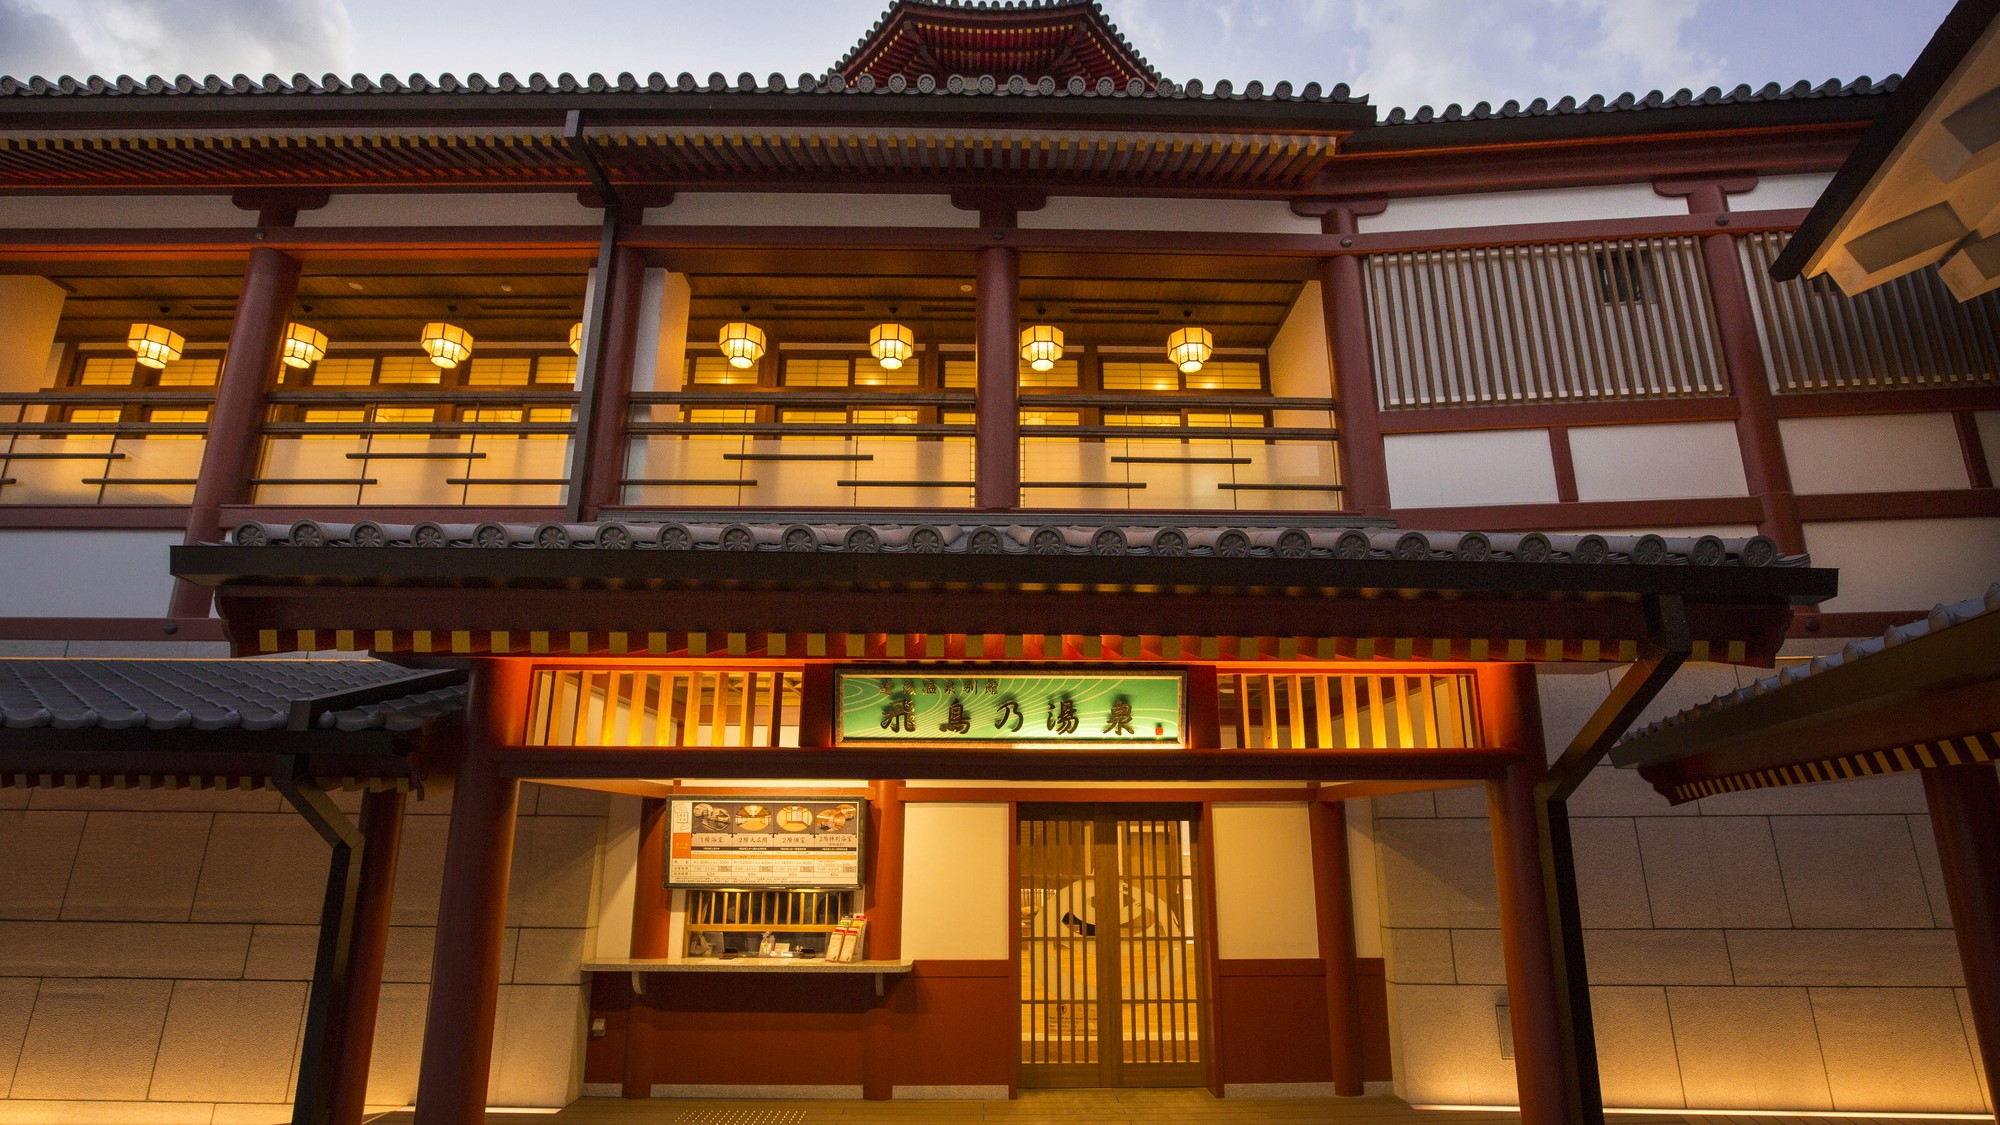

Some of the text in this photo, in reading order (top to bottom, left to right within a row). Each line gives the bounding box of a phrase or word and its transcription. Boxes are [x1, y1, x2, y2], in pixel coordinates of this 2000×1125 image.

[880, 699, 1136, 736] 飛鳥乃湯泉
